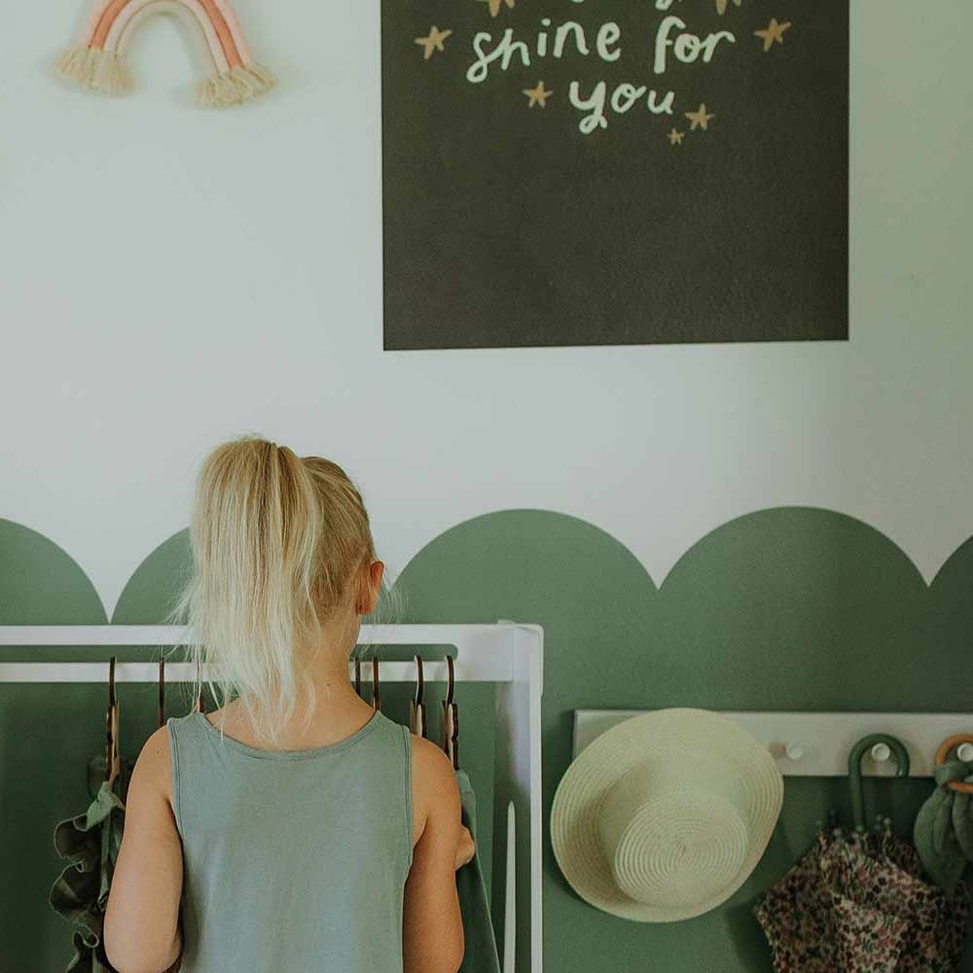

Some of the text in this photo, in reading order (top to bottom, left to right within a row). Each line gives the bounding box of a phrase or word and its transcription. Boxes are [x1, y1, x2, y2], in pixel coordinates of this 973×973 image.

[466, 16, 736, 83] shine for
[569, 80, 675, 134] you
